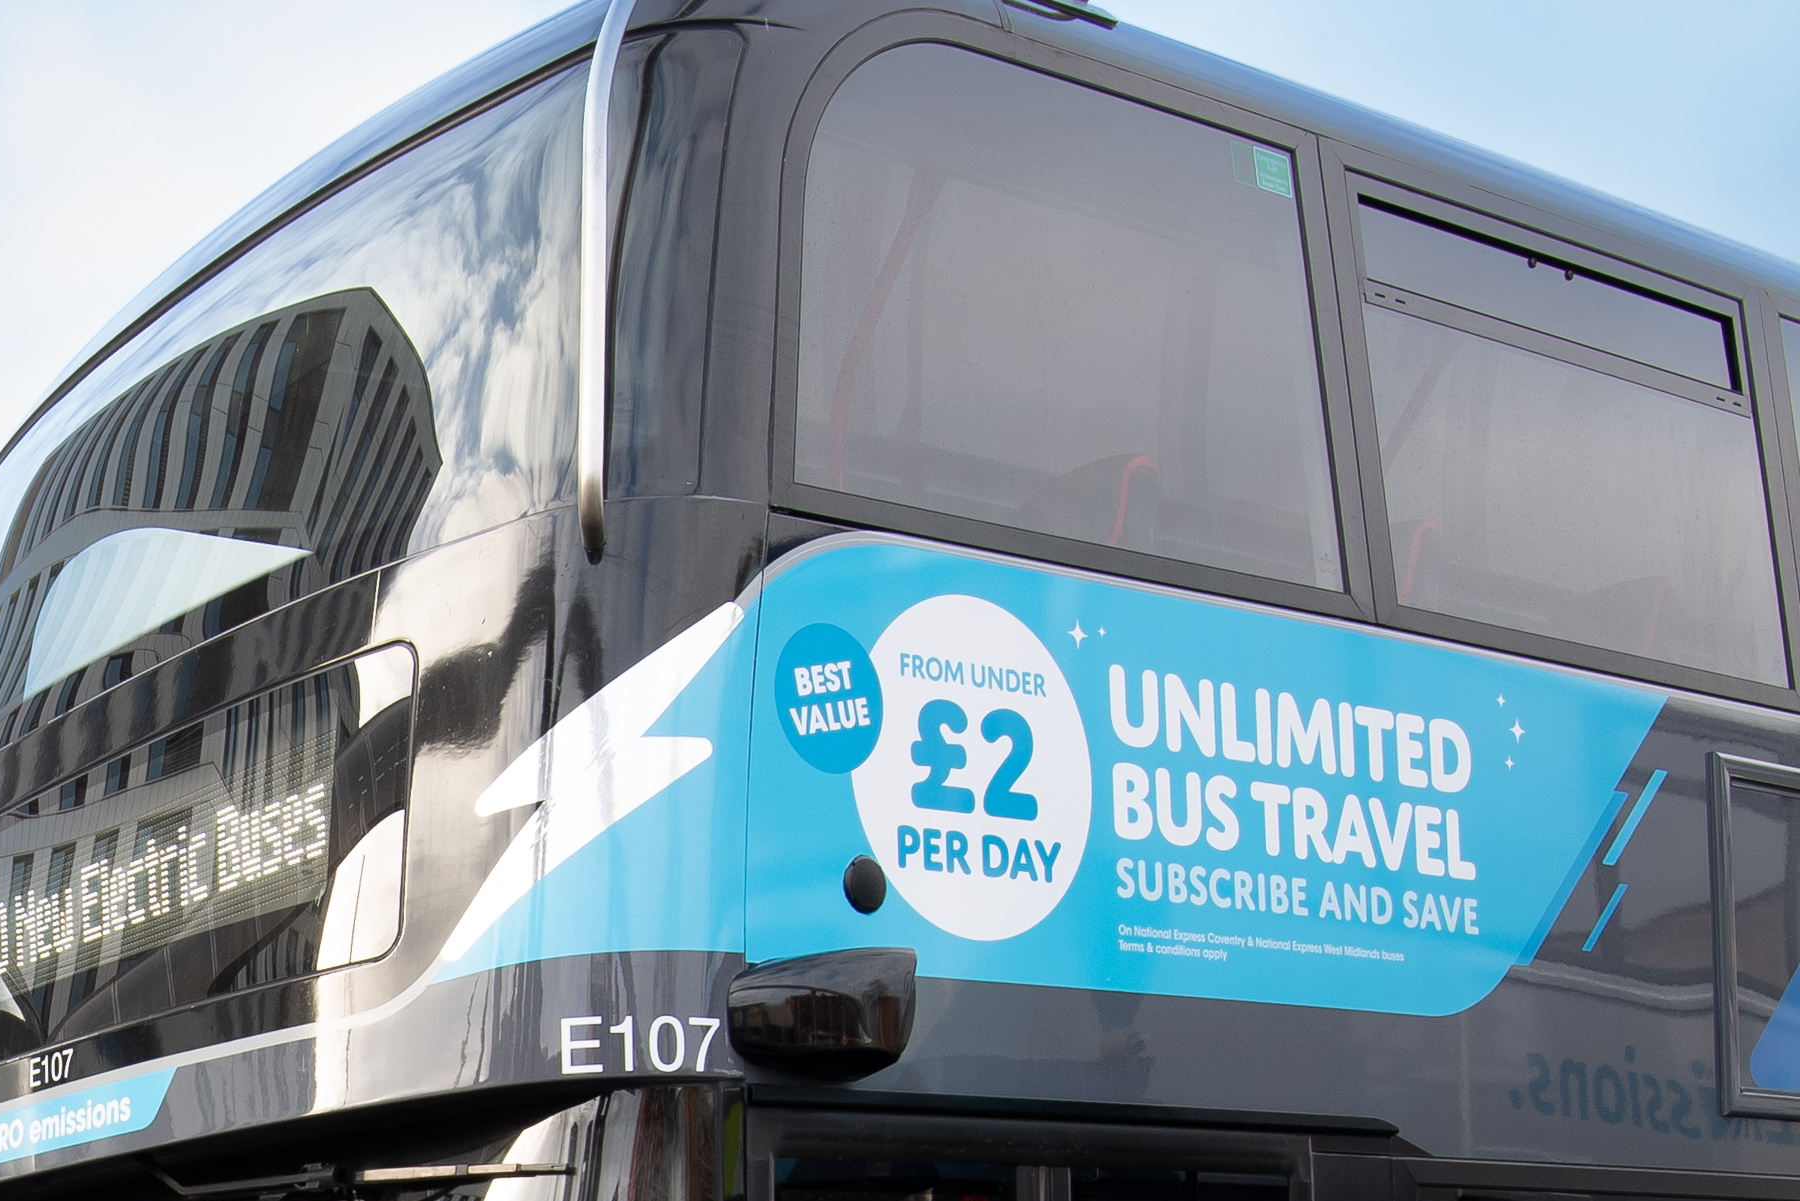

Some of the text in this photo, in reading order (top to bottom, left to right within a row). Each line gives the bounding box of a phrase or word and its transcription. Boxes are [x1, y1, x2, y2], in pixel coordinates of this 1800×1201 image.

[793, 660, 853, 697] BEST
[899, 652, 1047, 698] FROM UNDER
[789, 696, 871, 737] VALUE
[1108, 663, 1473, 794] UNLIMITED
[910, 698, 1039, 822] £2
[1111, 761, 1477, 881] BUS TRAVEL
[14, 887, 75, 967] New
[81, 825, 208, 943] Electric
[216, 782, 327, 892] Buses
[897, 824, 1062, 883] PER DAY
[1115, 856, 1480, 936] SUBSCRIBE AND SAVE
[1118, 923, 1405, 962] On National Express Coventry & National Express West Midlands buses
[1118, 939, 1228, 962] Terms & conditions apply
[29, 1047, 75, 1089] E107
[560, 1014, 721, 1075] E107
[28, 1095, 132, 1144] emissions
